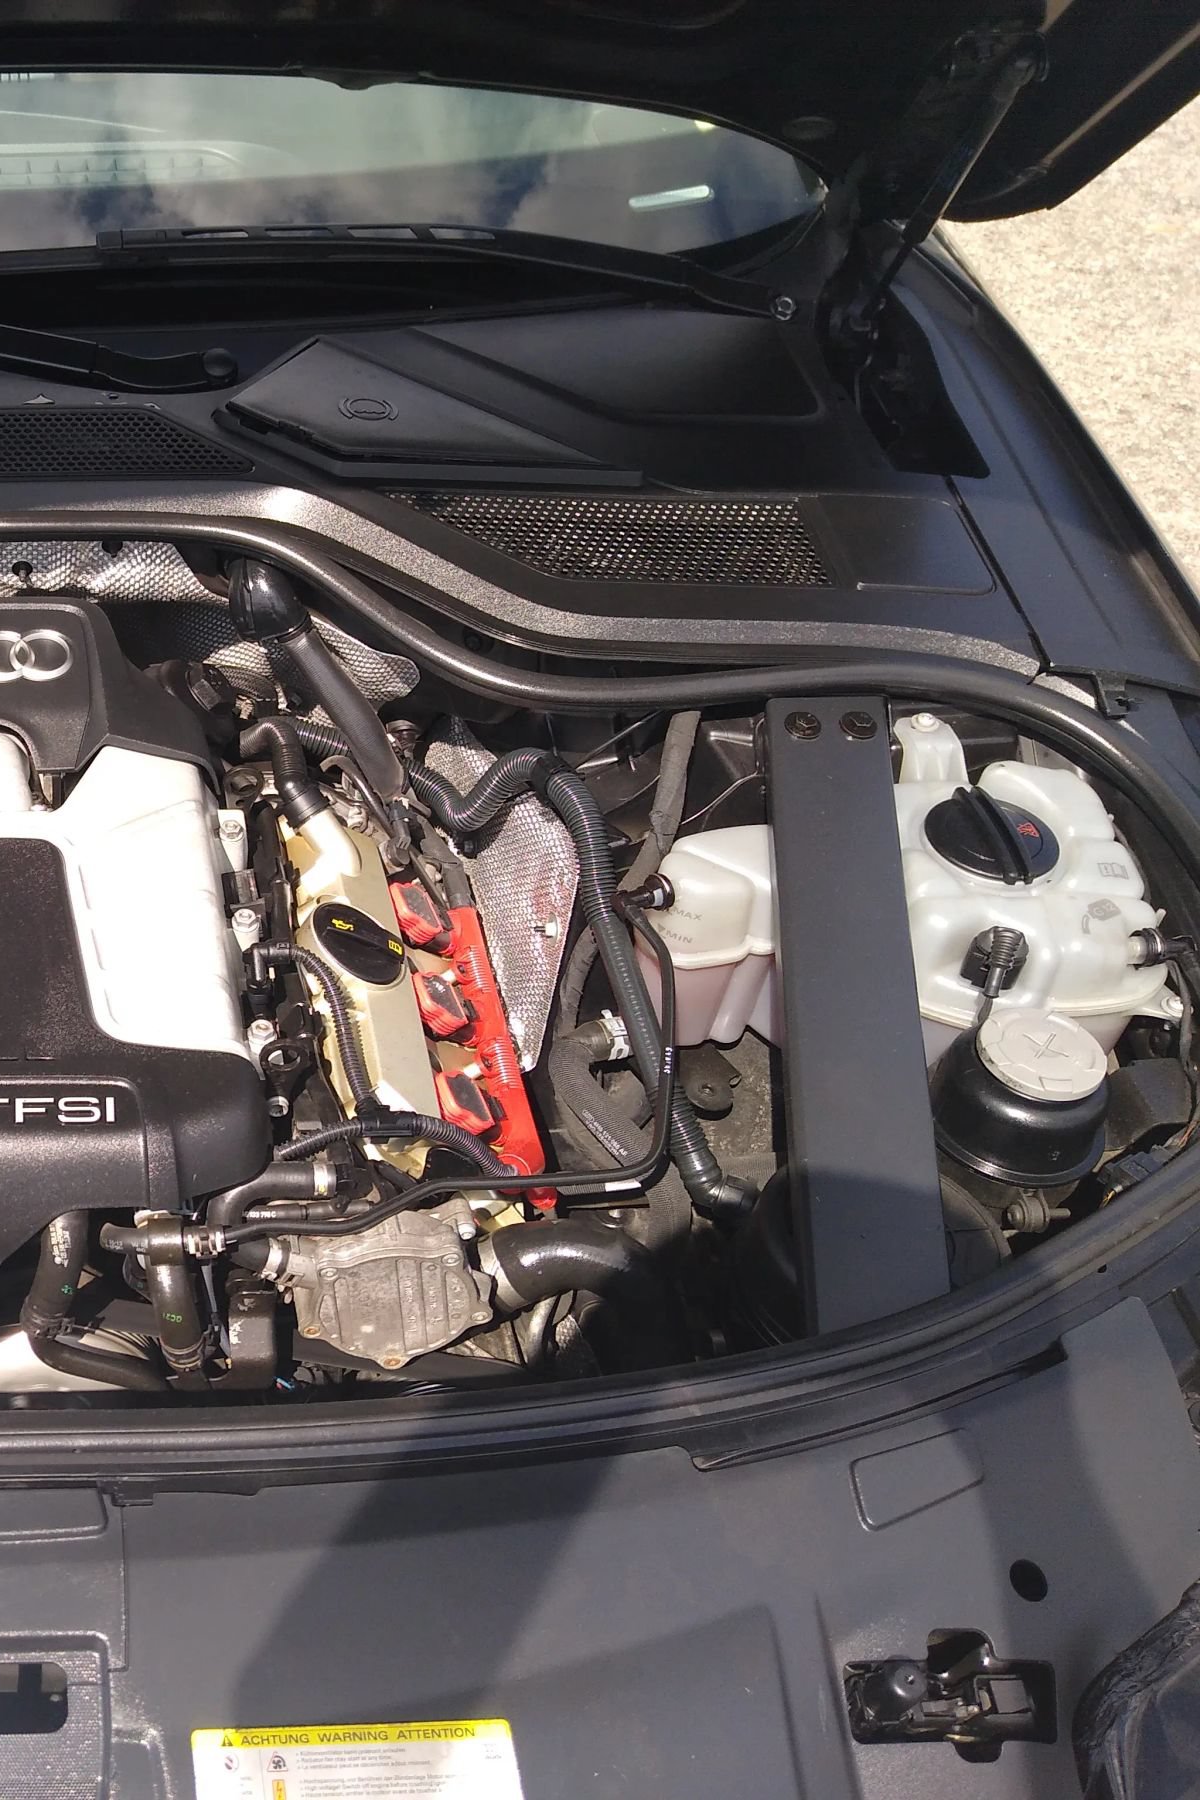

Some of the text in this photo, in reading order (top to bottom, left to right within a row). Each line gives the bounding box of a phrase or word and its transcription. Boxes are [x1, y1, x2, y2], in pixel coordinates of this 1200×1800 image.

[666, 930, 693, 943] MIN
[240, 1727, 476, 1746] ACHTUNG WARNING ATTENTION
